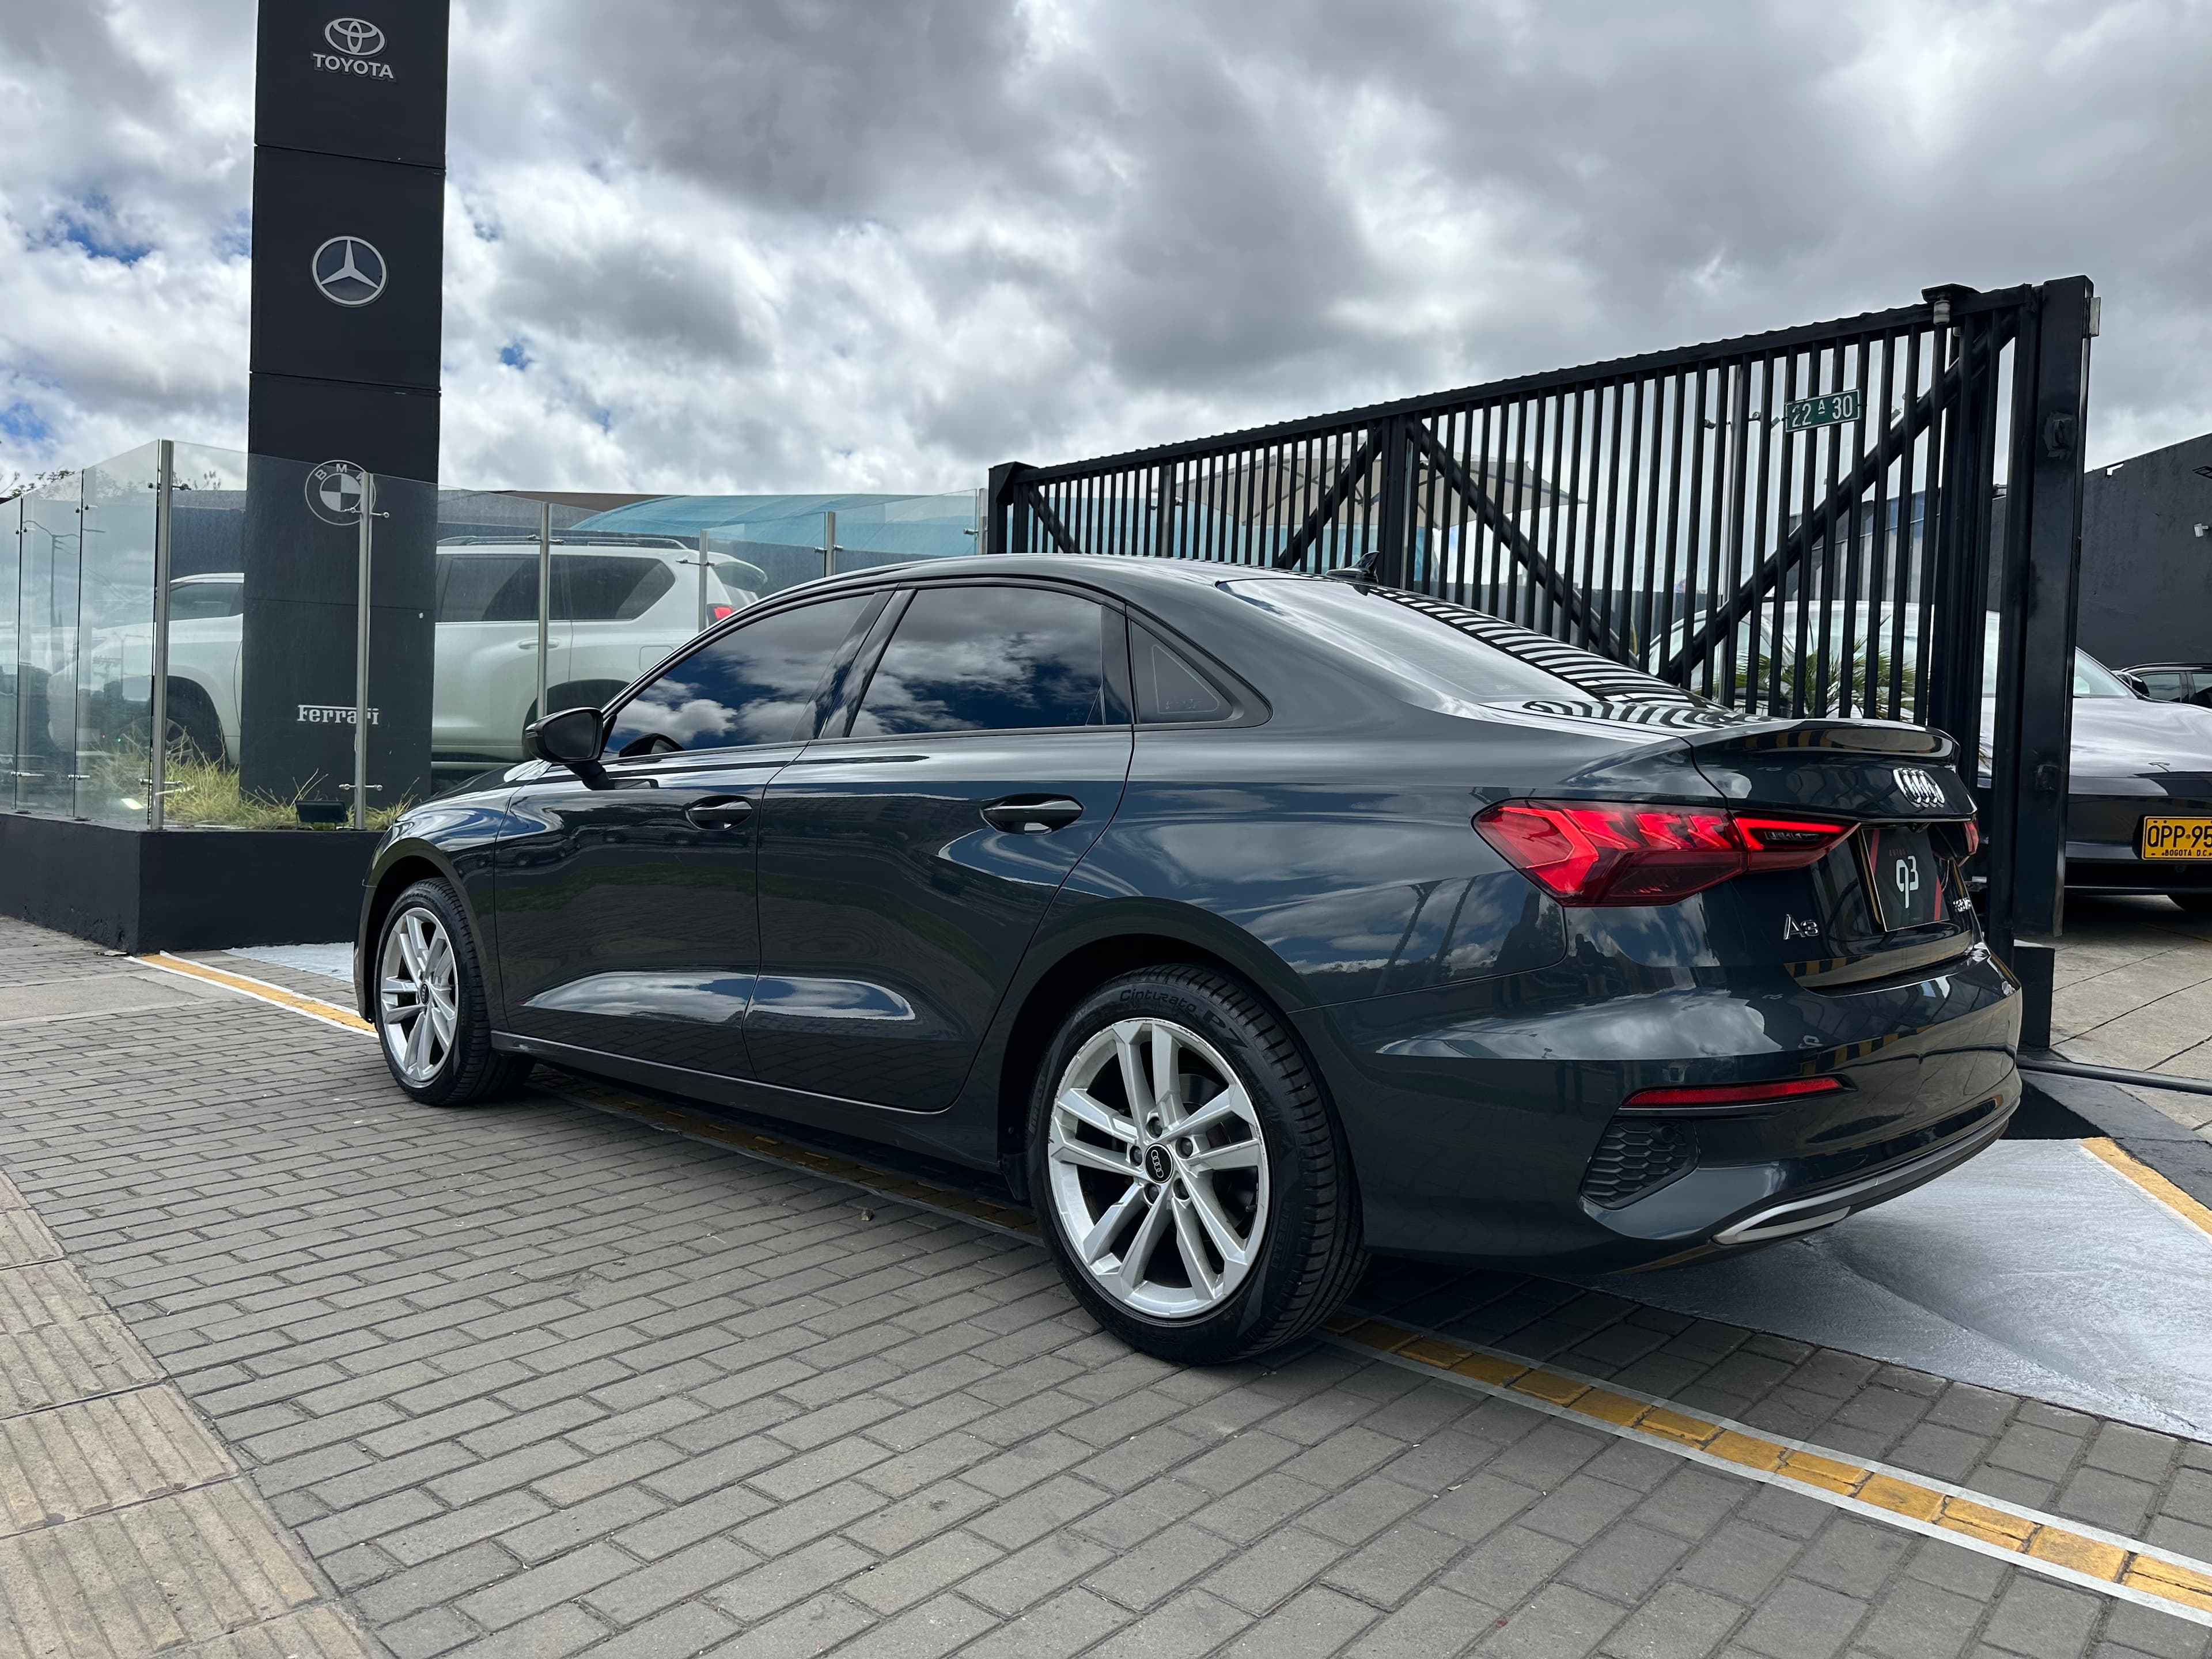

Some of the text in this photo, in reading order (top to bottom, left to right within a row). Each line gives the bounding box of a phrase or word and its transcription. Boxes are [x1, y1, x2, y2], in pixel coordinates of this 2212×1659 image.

[313, 53, 394, 79] TOYOTA
[1792, 395, 1853, 427] 22 A 30
[297, 704, 380, 725] Ferrai
[1783, 914, 1819, 940] A3
[1119, 988, 1197, 1013] Cinturato
